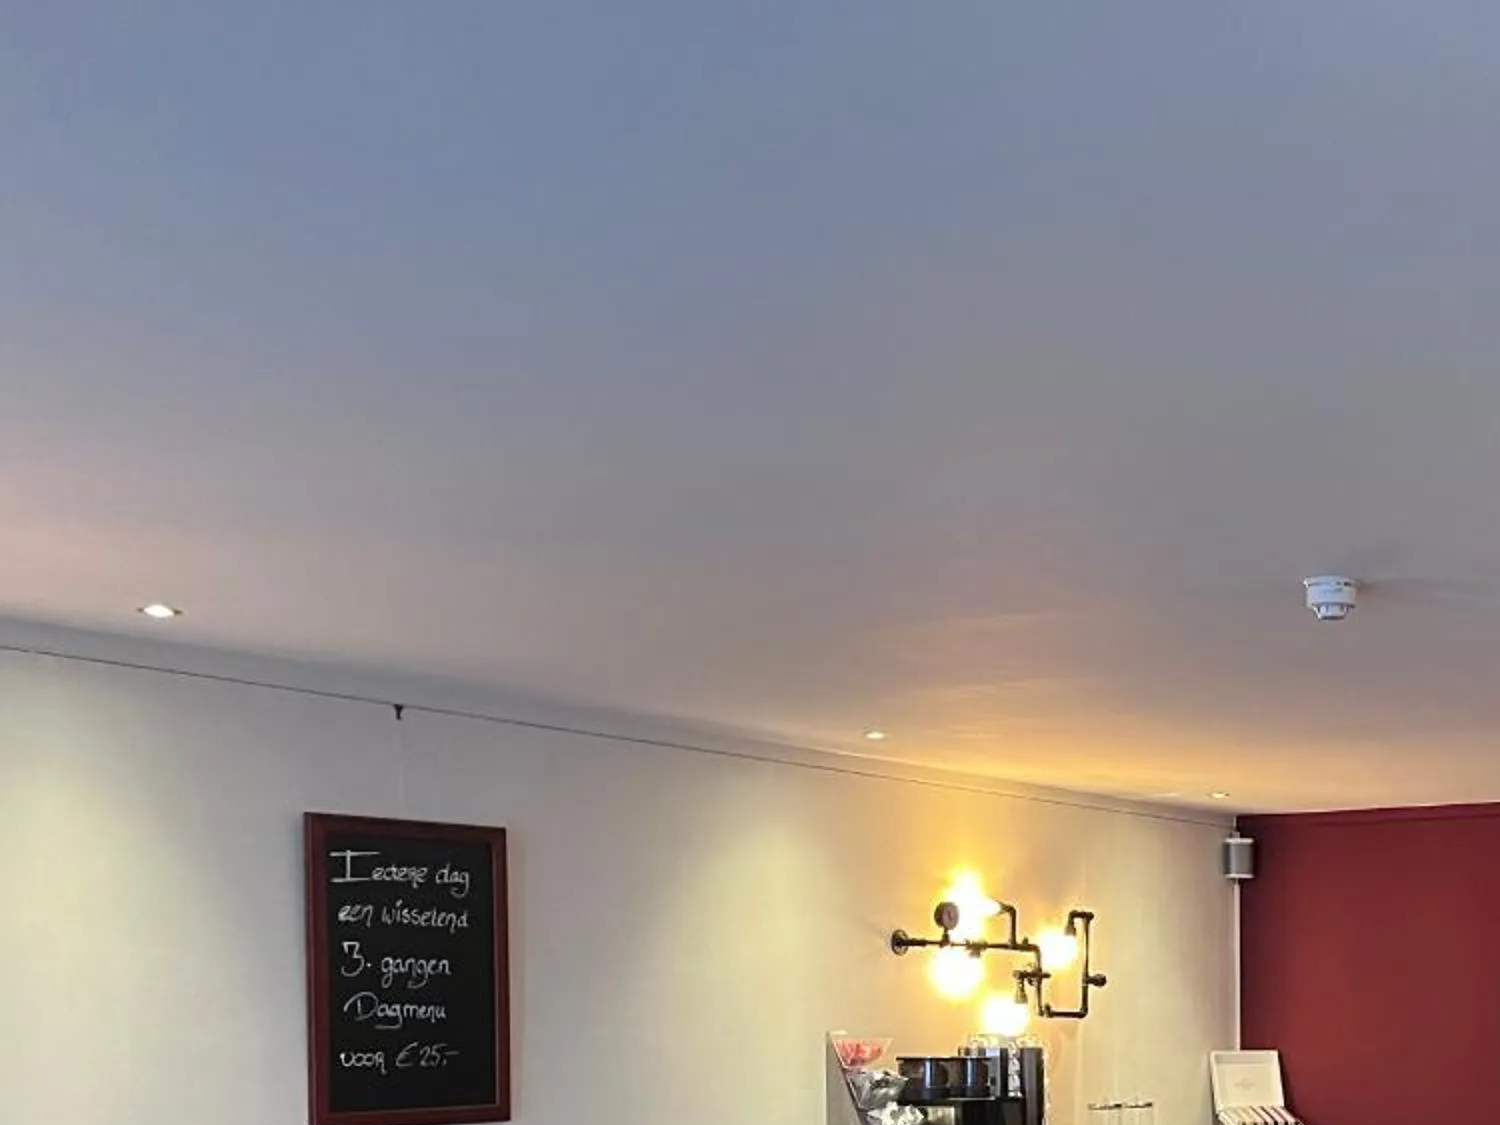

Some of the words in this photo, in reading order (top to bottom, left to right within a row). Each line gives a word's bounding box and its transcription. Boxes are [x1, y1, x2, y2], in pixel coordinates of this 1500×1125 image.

[436, 862, 469, 898] dag
[338, 904, 373, 928] een
[382, 899, 468, 933] wisselend
[381, 957, 451, 989] gangen
[344, 991, 446, 1029] Dagmenu
